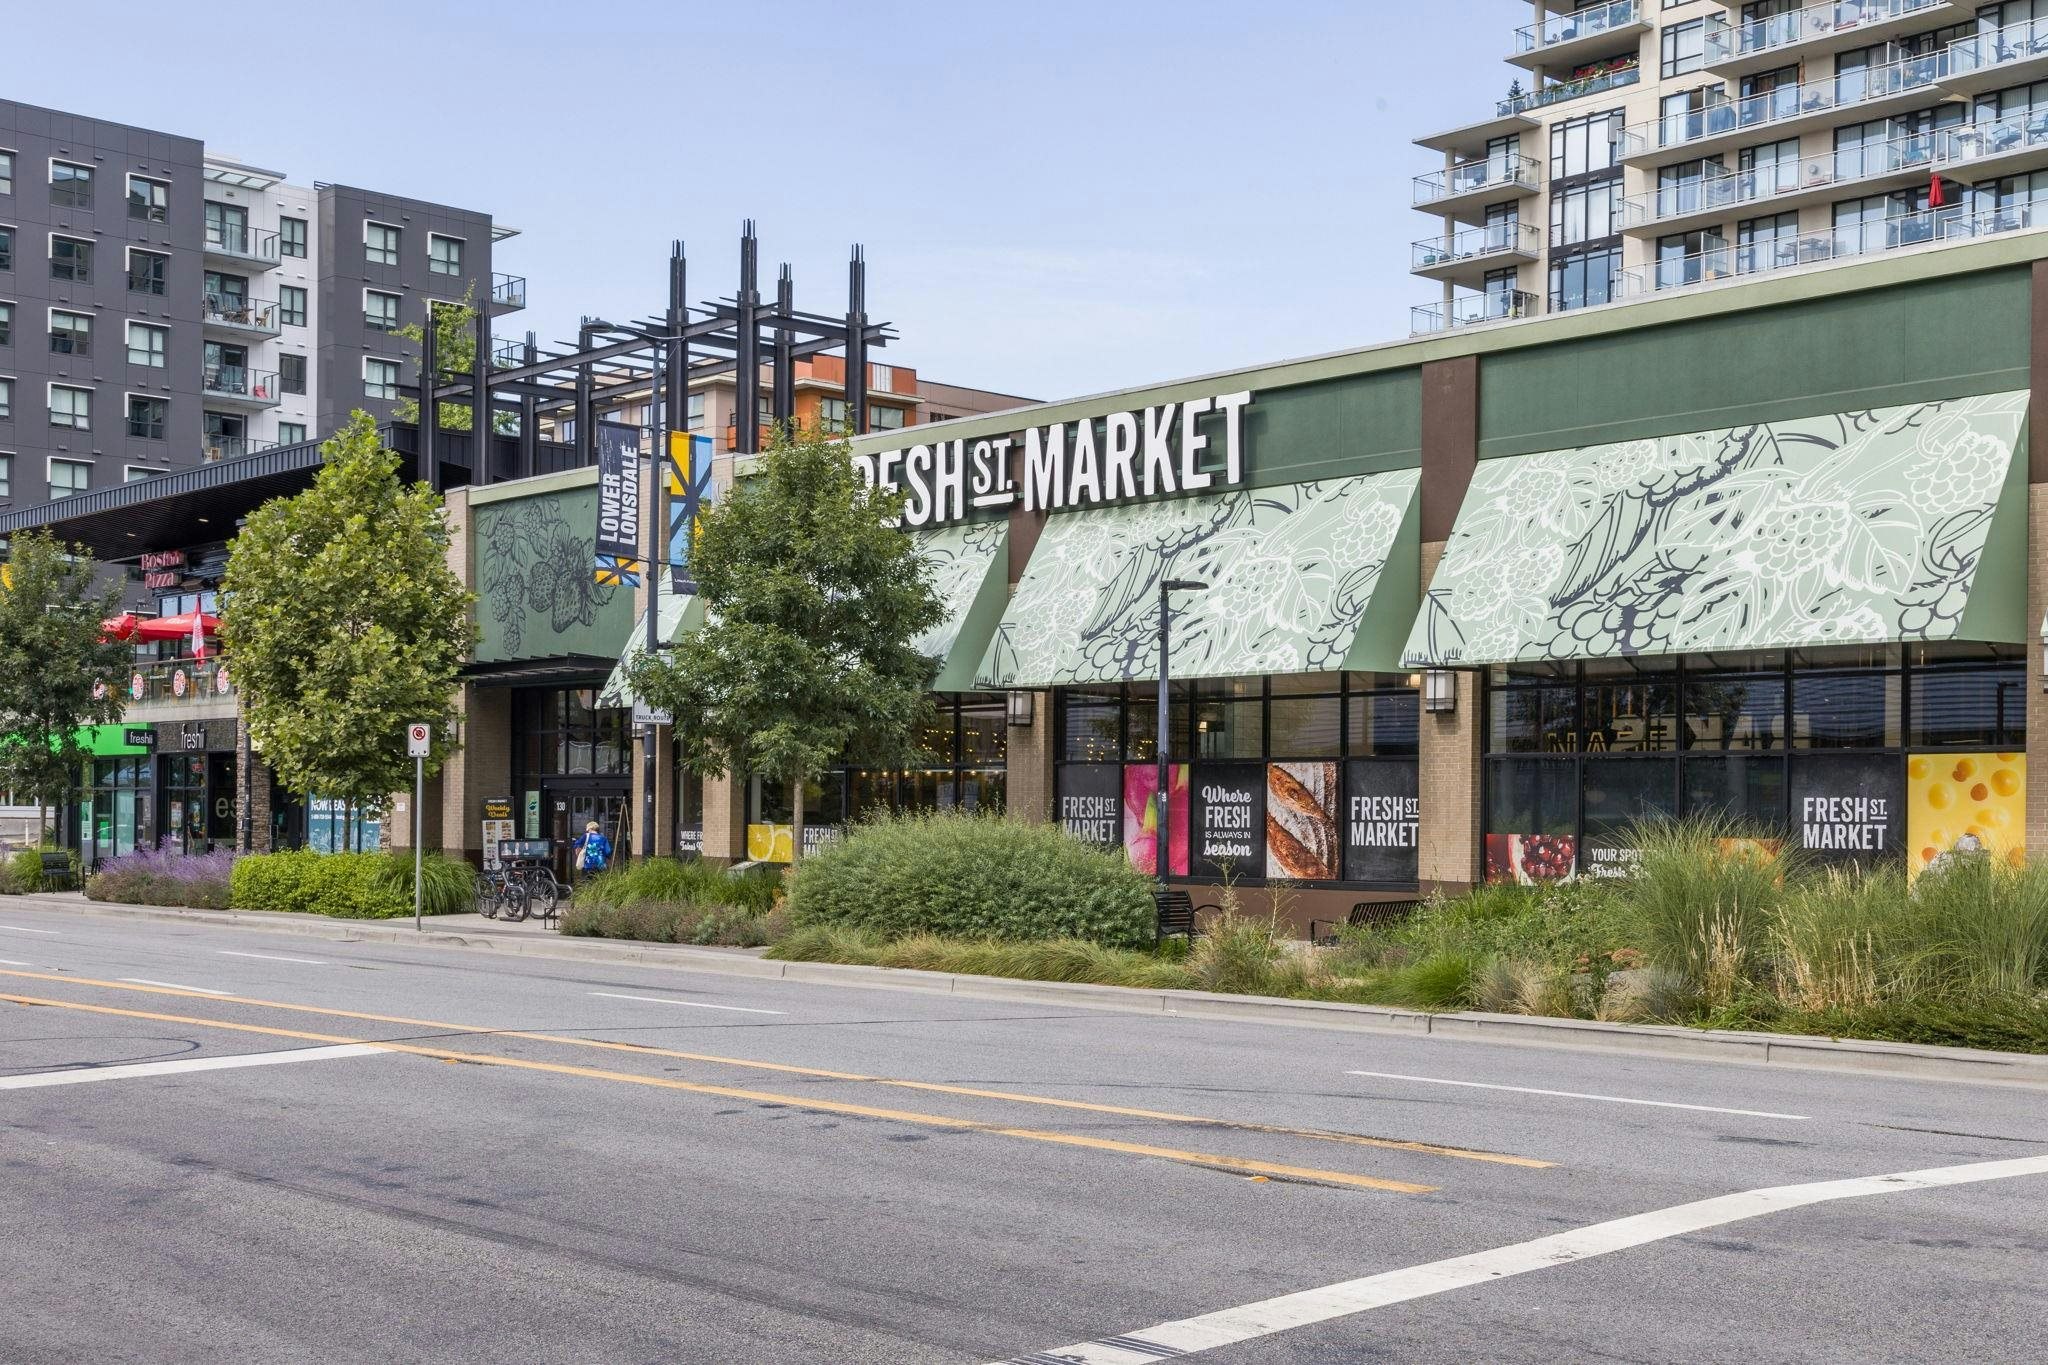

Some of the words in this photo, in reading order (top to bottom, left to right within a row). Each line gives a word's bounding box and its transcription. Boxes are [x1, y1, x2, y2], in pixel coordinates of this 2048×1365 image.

[850, 438, 964, 528] RESH
[1023, 390, 1252, 512] MARKET
[600, 472, 621, 542] LOWER
[619, 445, 638, 546] LONSDALE
[144, 572, 175, 589] Pizza
[181, 723, 205, 749] freshii
[311, 799, 327, 811] NOW
[1202, 785, 1252, 803] Where
[1063, 796, 1103, 818] FRESH
[1205, 805, 1251, 828] FRESH
[1351, 796, 1403, 820] FRESH
[1803, 797, 1868, 822] FRESH
[803, 827, 831, 844] FRESH
[1062, 819, 1116, 842] MARKET
[1351, 822, 1419, 847] MARKET
[1803, 823, 1887, 850] MARKET
[1203, 840, 1252, 856] season
[1592, 848, 1617, 862] YOUR
